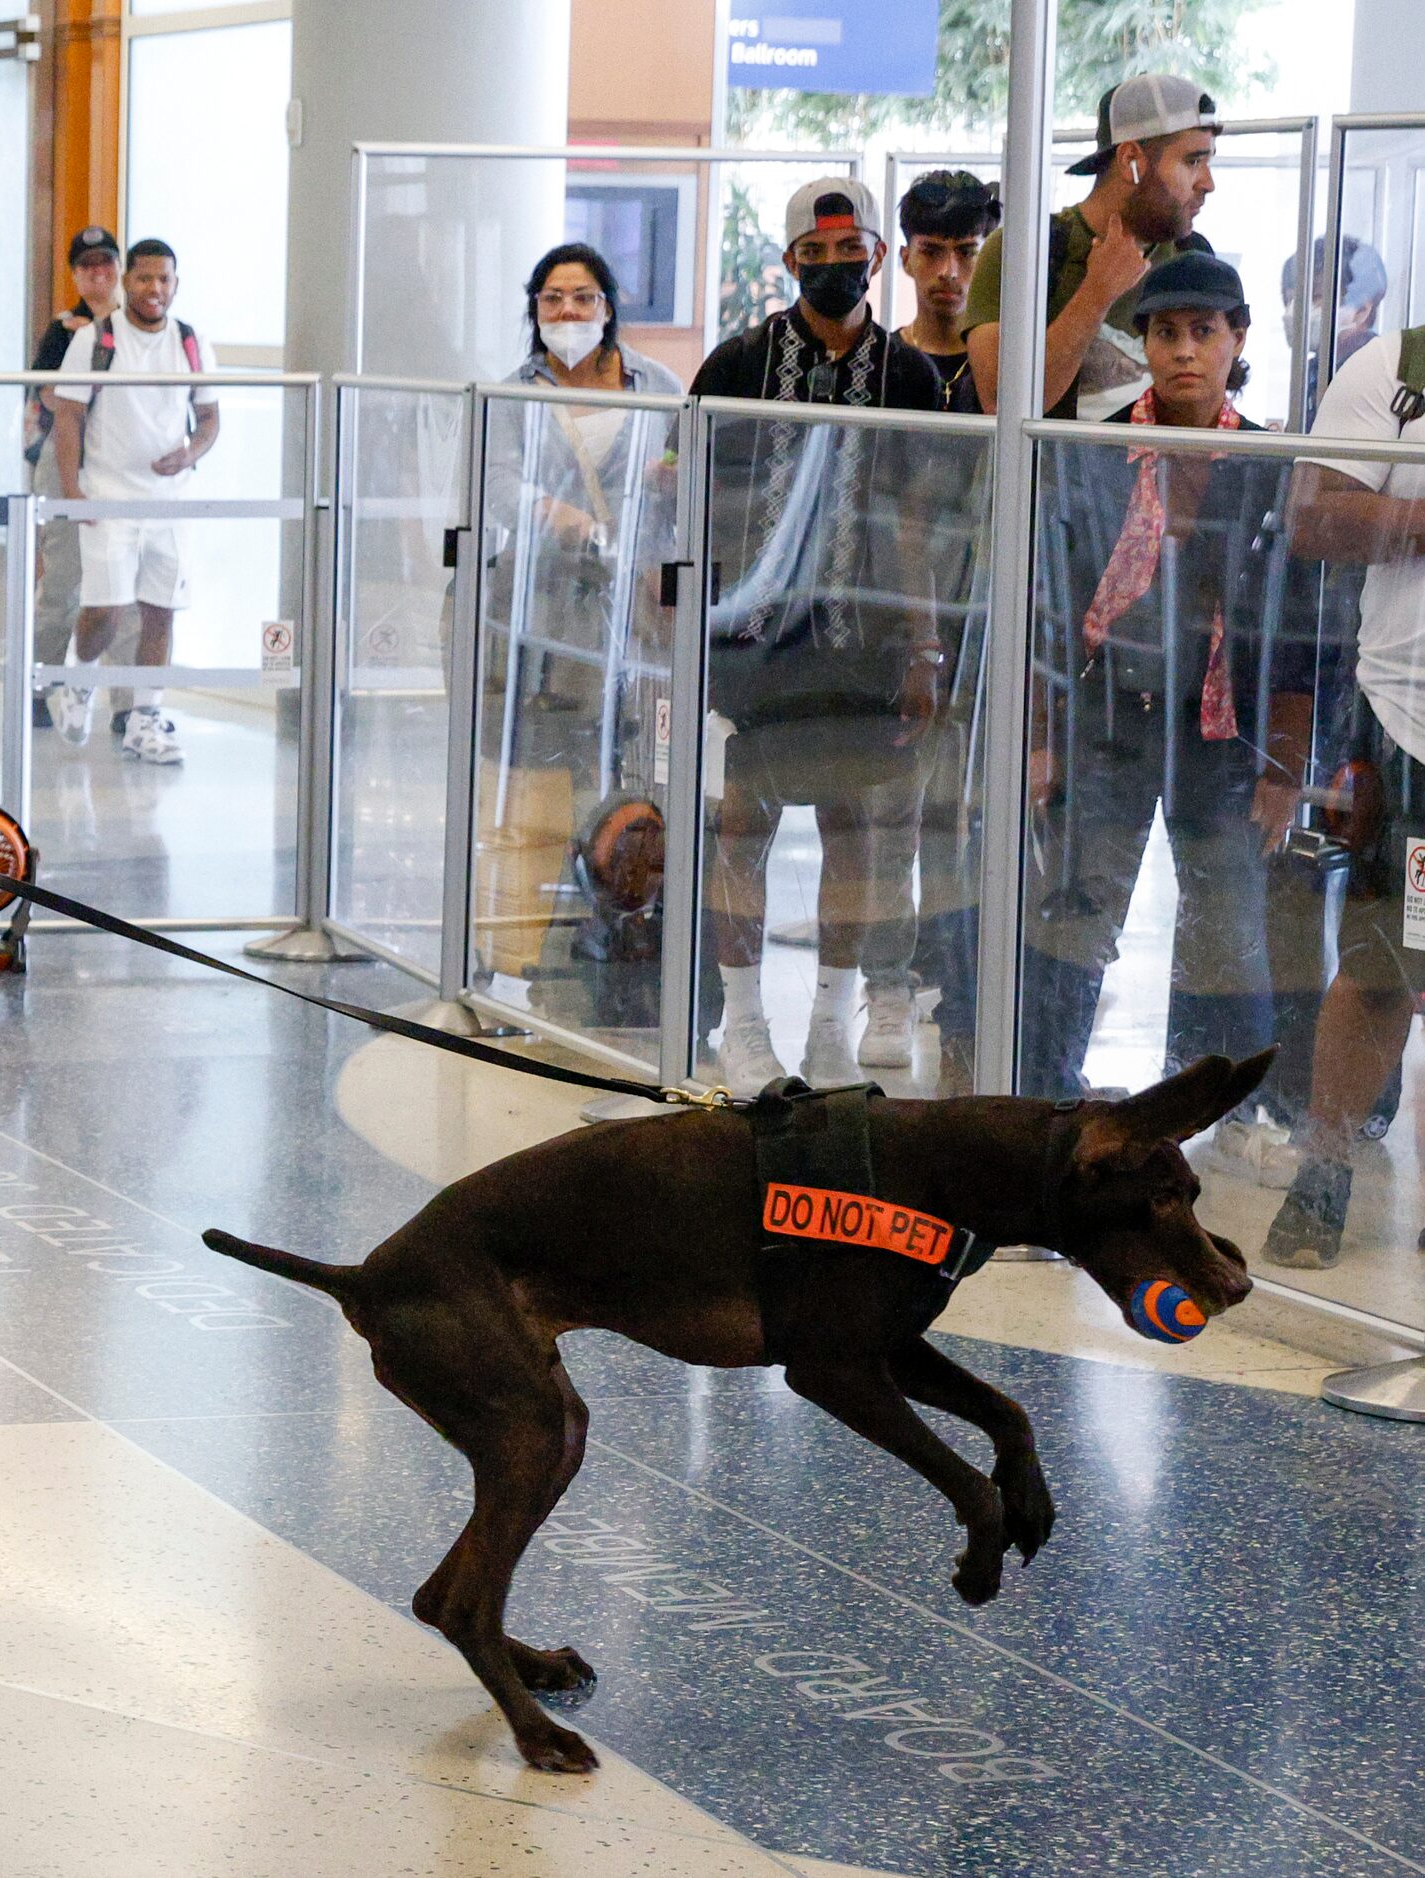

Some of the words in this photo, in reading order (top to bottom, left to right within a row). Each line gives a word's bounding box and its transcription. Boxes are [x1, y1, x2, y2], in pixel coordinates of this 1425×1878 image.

[731, 41, 817, 66] Ballroom
[770, 1190, 813, 1230] DO
[819, 1197, 884, 1241] NOT
[891, 1211, 947, 1256] PET
[534, 1511, 787, 1631] MEMBE
[755, 1651, 1064, 1784] BOARD
